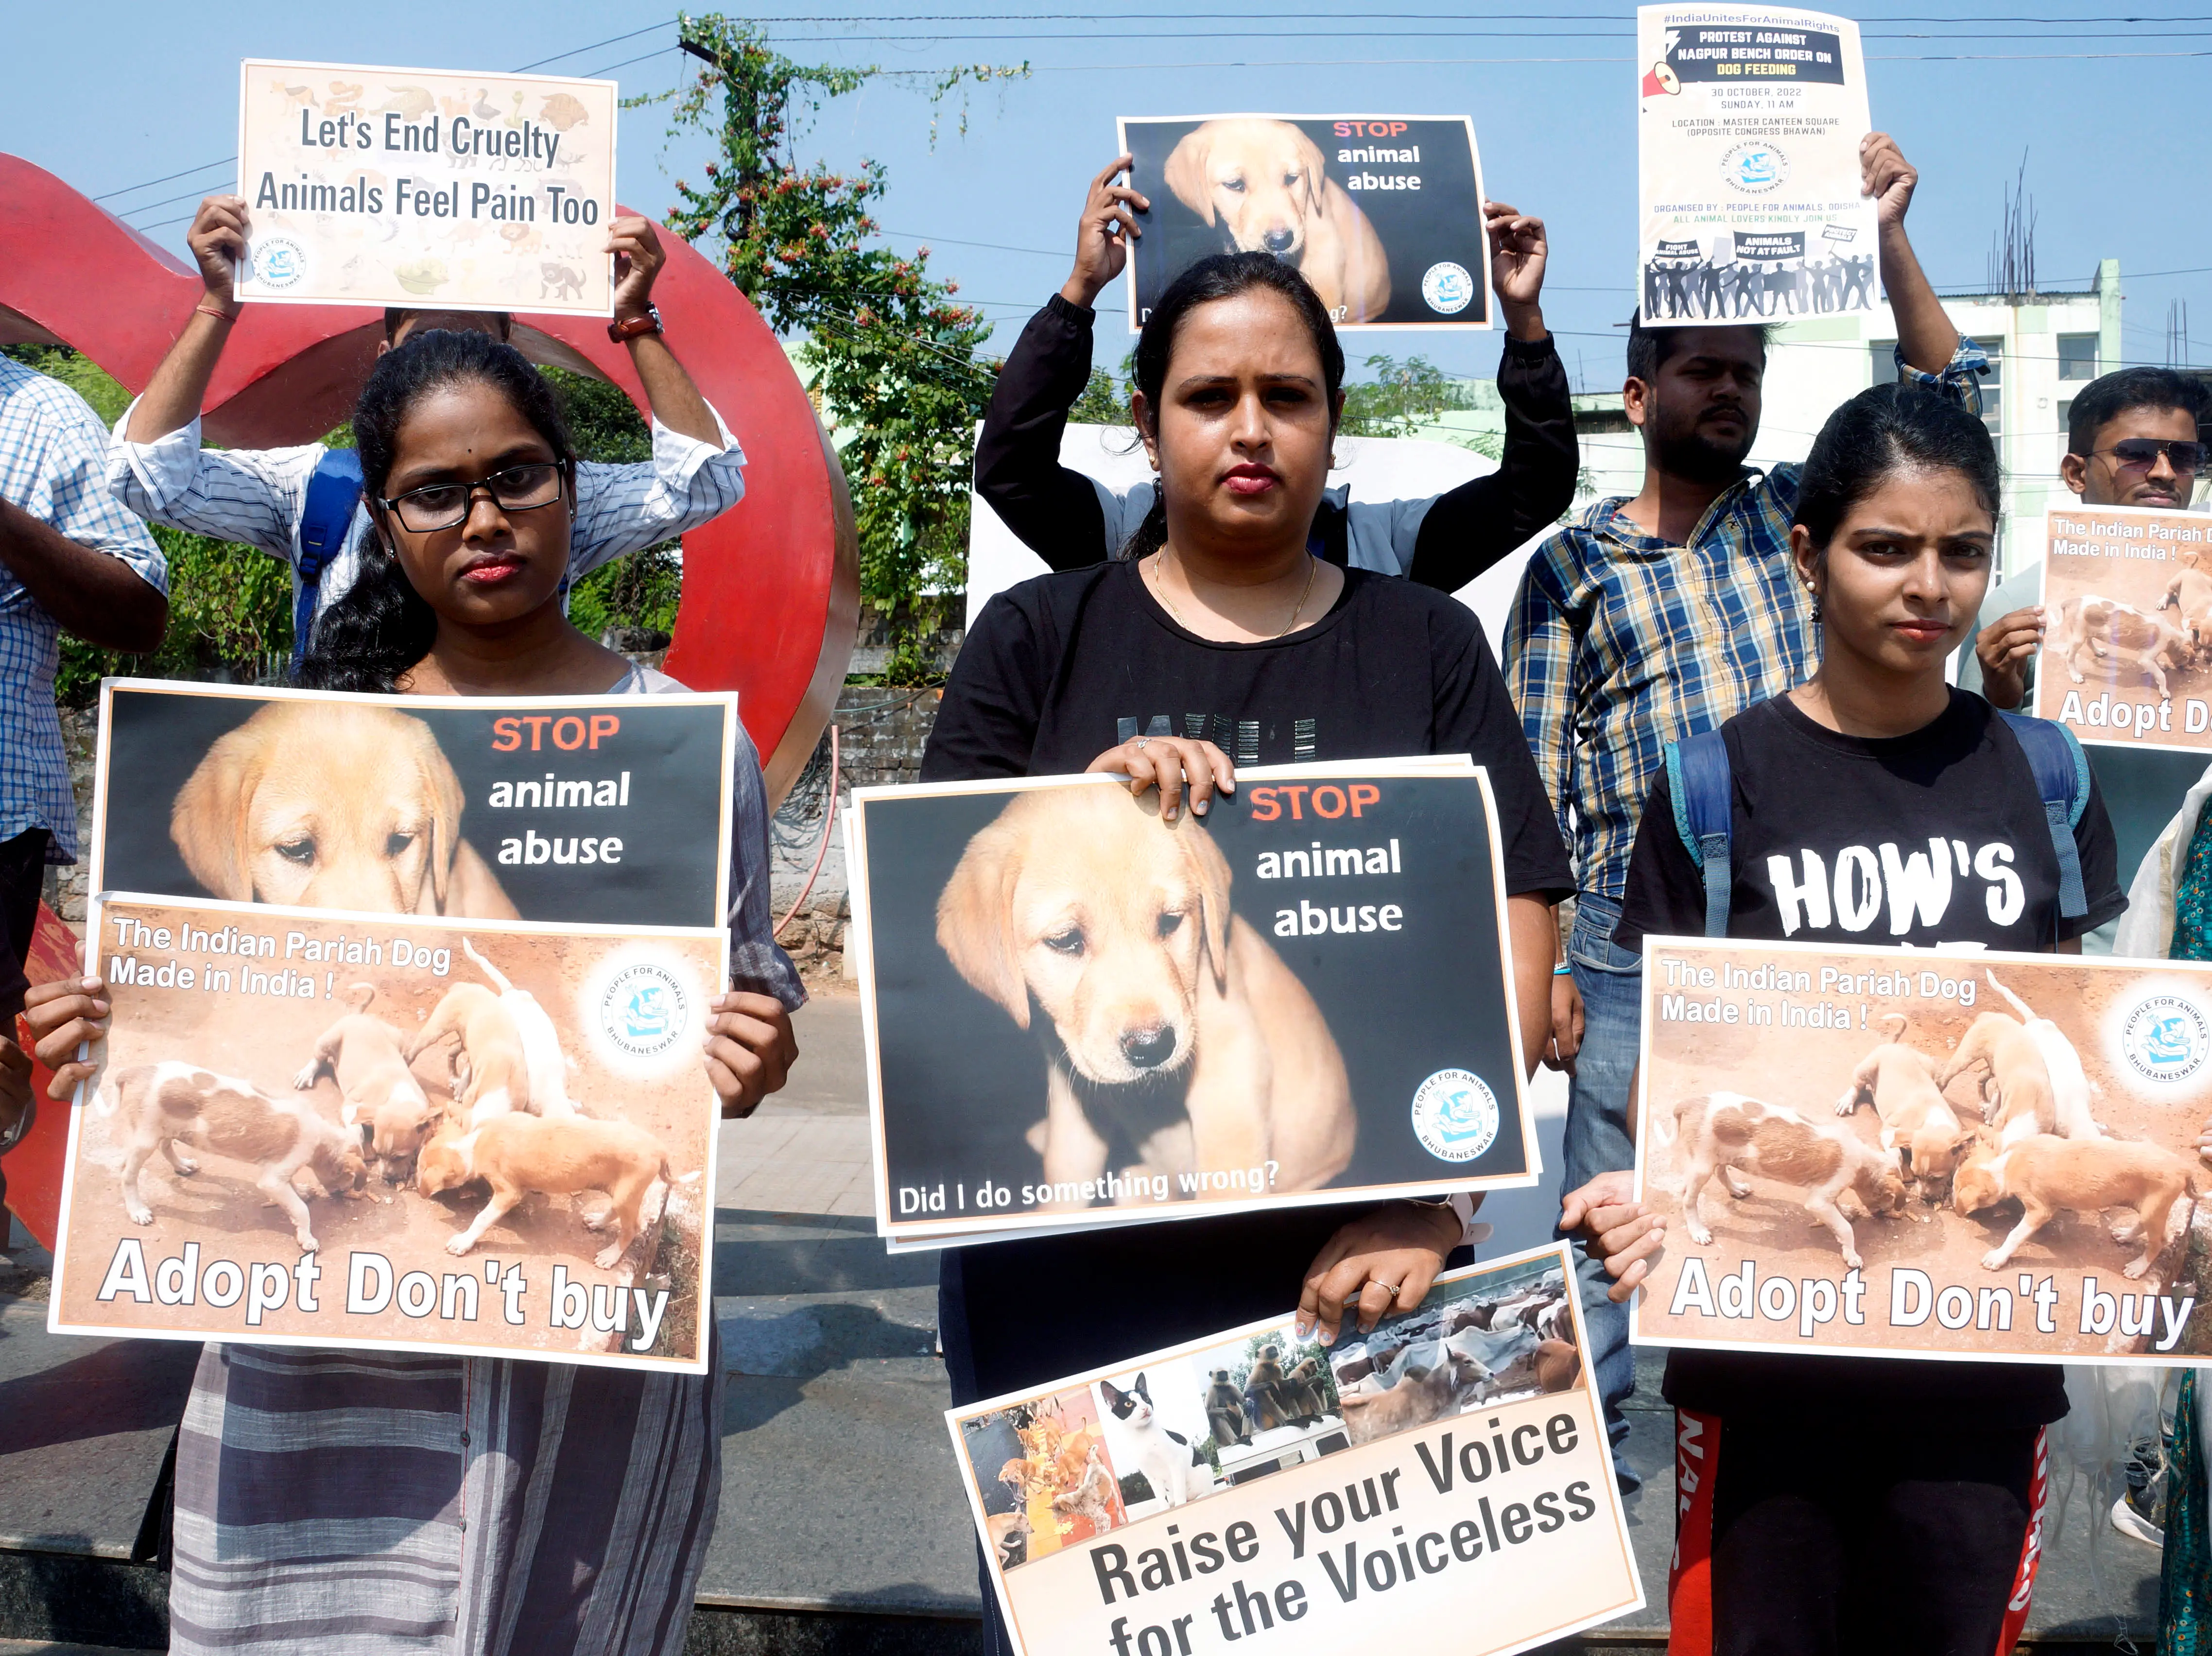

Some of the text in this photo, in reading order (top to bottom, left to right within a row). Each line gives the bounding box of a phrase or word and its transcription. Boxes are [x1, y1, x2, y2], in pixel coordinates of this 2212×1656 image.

[1664, 14, 1839, 33] #IndiaUnitesForAnimalRights
[1700, 32, 1806, 45] PROTEST AGAINST
[1678, 48, 1832, 63] NAGPUR BENCH ORDER ON
[1717, 64, 1796, 75] DOG FEEDING
[1711, 88, 1723, 97] 30
[1334, 122, 1408, 137] STOP
[1672, 119, 1714, 127] LOCATION
[1723, 118, 1759, 126] MASTER
[1806, 118, 1840, 126] SQUARE
[1687, 127, 1825, 138] (OPPOSITE CONGRESS BHAWAN)
[302, 108, 559, 168] Let's End Cruelty
[1338, 146, 1419, 163] animal
[1721, 144, 1742, 166] PEOPLE
[1763, 143, 1788, 166] ANIMALS
[1348, 172, 1421, 190] abuse
[1726, 177, 1784, 194] BHUBANESWAR
[256, 172, 598, 225] Animals Feel Pain Too
[1654, 204, 1703, 213] ORGANISED
[1829, 202, 1860, 210] ODISHA
[1731, 214, 1765, 223] LOVERS
[254, 243, 269, 262] PEOPLE
[286, 242, 304, 262] ANIMALS
[1736, 245, 1757, 255] NOT
[1771, 244, 1800, 255] FAULT
[1745, 237, 1792, 246] ANIMALS
[257, 273, 301, 288] BHUBANESWAR
[1424, 267, 1437, 286] PEOPLE
[1453, 265, 1471, 286] ANIMALS
[1427, 297, 1468, 312] BHUBANESWAR
[2054, 518, 2086, 535] The
[2091, 520, 2143, 538] Indian
[2148, 523, 2202, 543] Pariah
[2054, 540, 2176, 561] Made in India !
[2058, 690, 2212, 738] Adopt D
[492, 715, 620, 751] STOP
[489, 772, 630, 808] animal
[1249, 784, 1381, 821] STOP
[498, 830, 623, 865] abuse
[1256, 839, 1401, 879] animal
[1767, 837, 2025, 936] HOW'S
[1274, 899, 1403, 937] abuse
[113, 918, 451, 976] The Indian Pariah Dog
[109, 955, 334, 1000] Made in India !
[605, 971, 631, 1006] PEOPLE
[656, 970, 685, 1010] ANIMALS
[1661, 959, 1976, 1007] The Indian Pariah Dog
[1661, 994, 1867, 1030] Made in India !
[2126, 1002, 2152, 1035] PEOPLE
[2177, 1002, 2207, 1039] ANIMALS
[607, 1027, 678, 1054] BHUBANESWAR
[2129, 1053, 2200, 1080] BHUBANESWAR
[1415, 1072, 1495, 1115] PEOPLE FOR ANIMALS
[1422, 1131, 1493, 1159] BHUBANESWAR
[899, 1160, 1280, 1214] Did I do something wrong?
[97, 1238, 669, 1352] Adopt Don't buy
[1668, 1257, 2195, 1351] Adopt Don't buy
[1089, 1520, 1259, 1605] Raise
[1274, 1466, 1403, 1559] your
[1414, 1413, 1580, 1495] Voice
[1109, 1481, 1597, 1656] for the Voiceless
